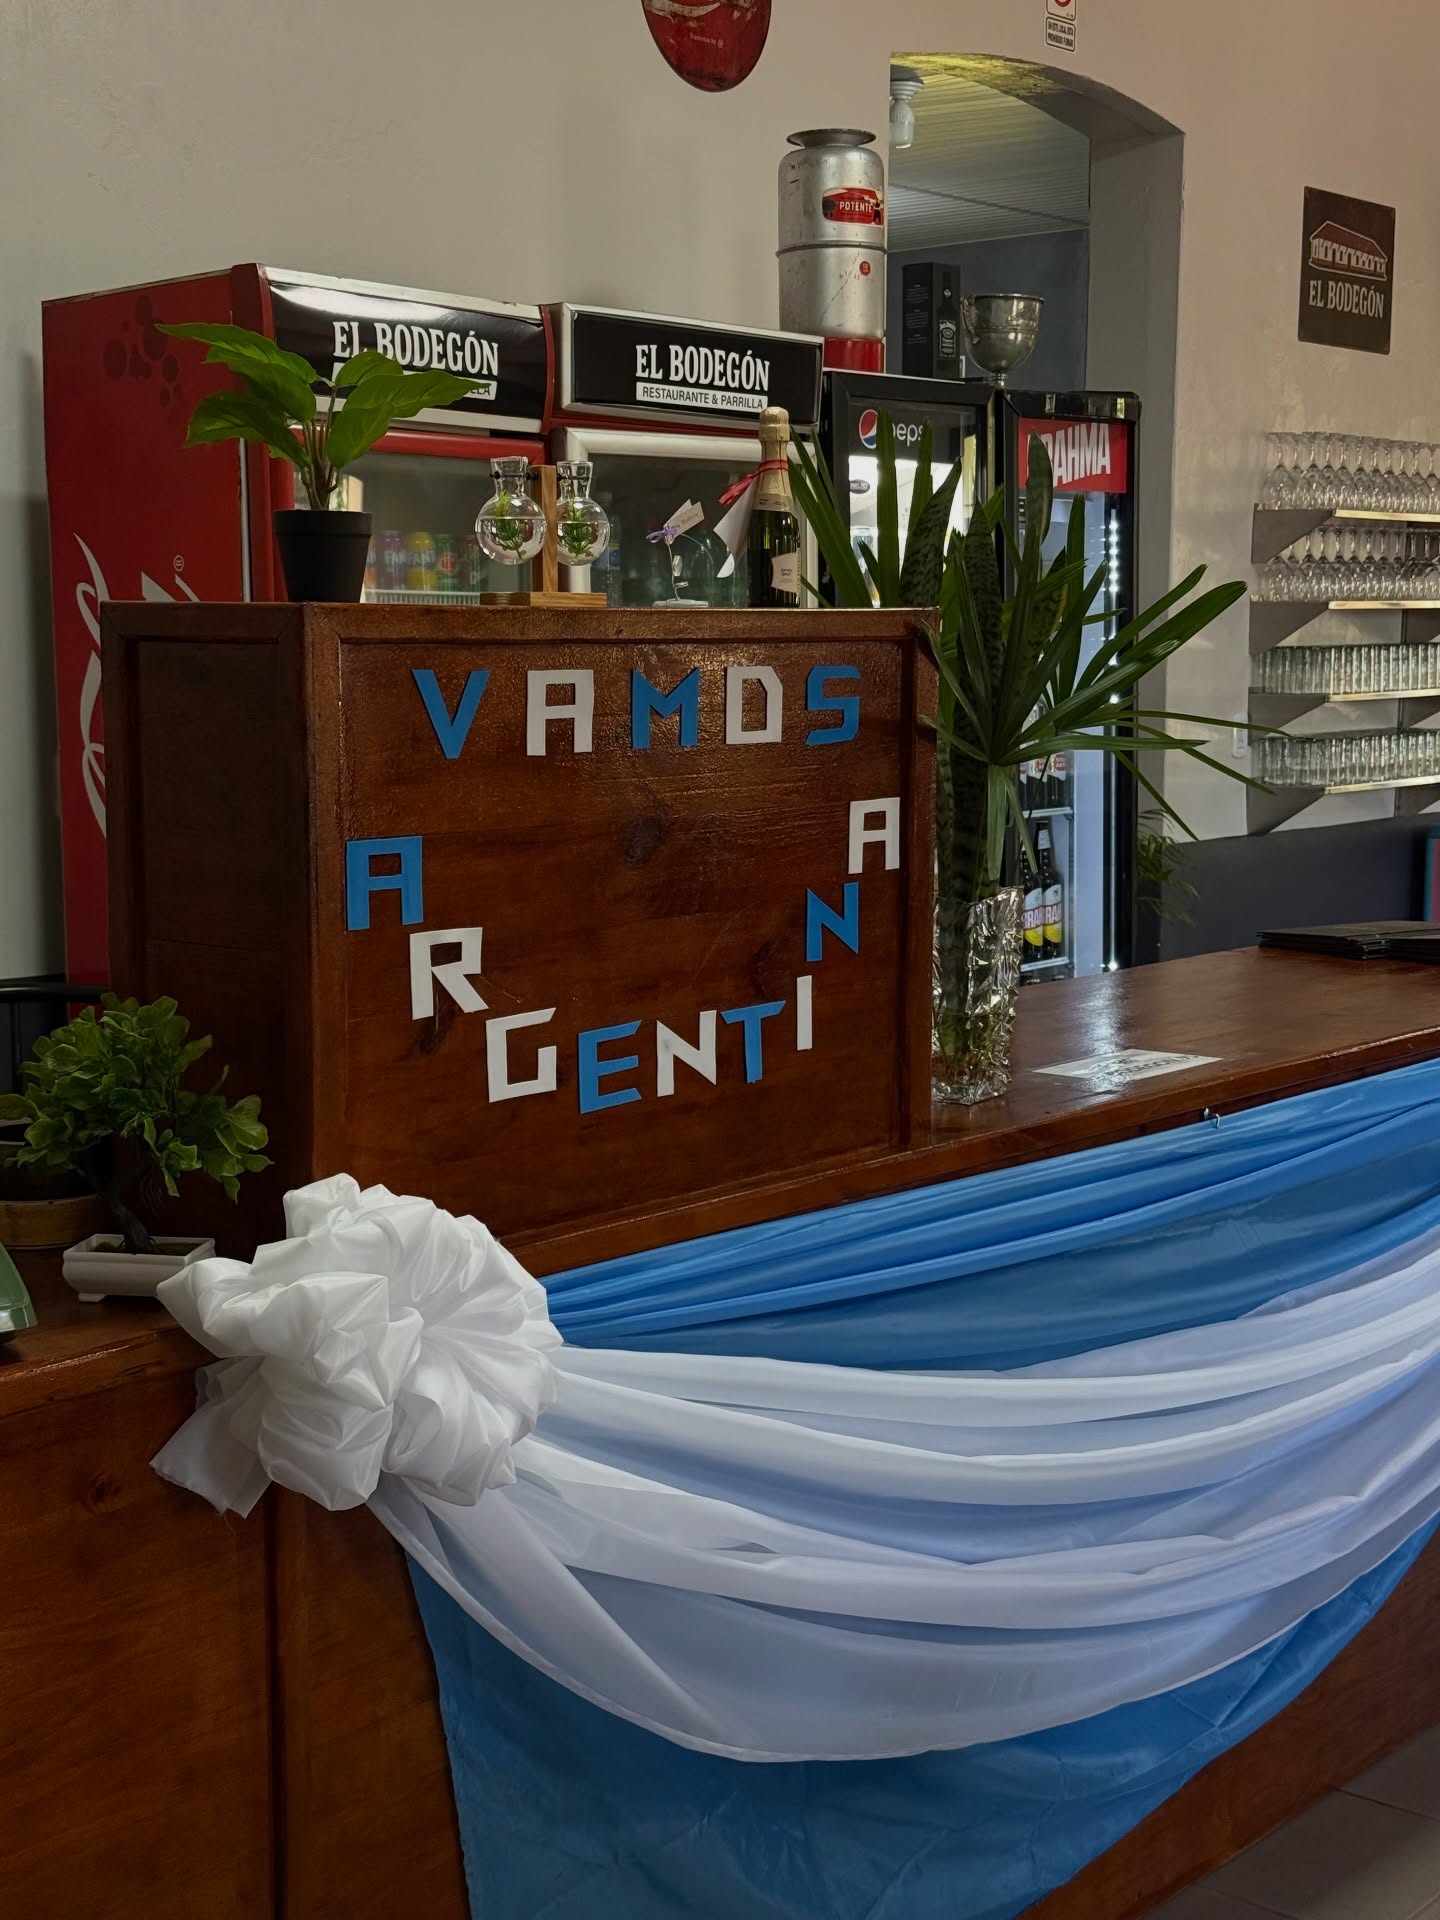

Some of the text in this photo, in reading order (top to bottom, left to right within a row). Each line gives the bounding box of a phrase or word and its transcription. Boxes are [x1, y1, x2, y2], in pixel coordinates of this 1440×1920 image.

[1309, 280, 1384, 319] EL BODEGÓN
[333, 321, 499, 377] EL BODEGÓN
[635, 344, 770, 392] EL BODEGÓN
[642, 386, 763, 410] RESTAURANTE & PARRILLA
[411, 665, 862, 759] VAMOS
[346, 796, 901, 1114] ARGENTINA
